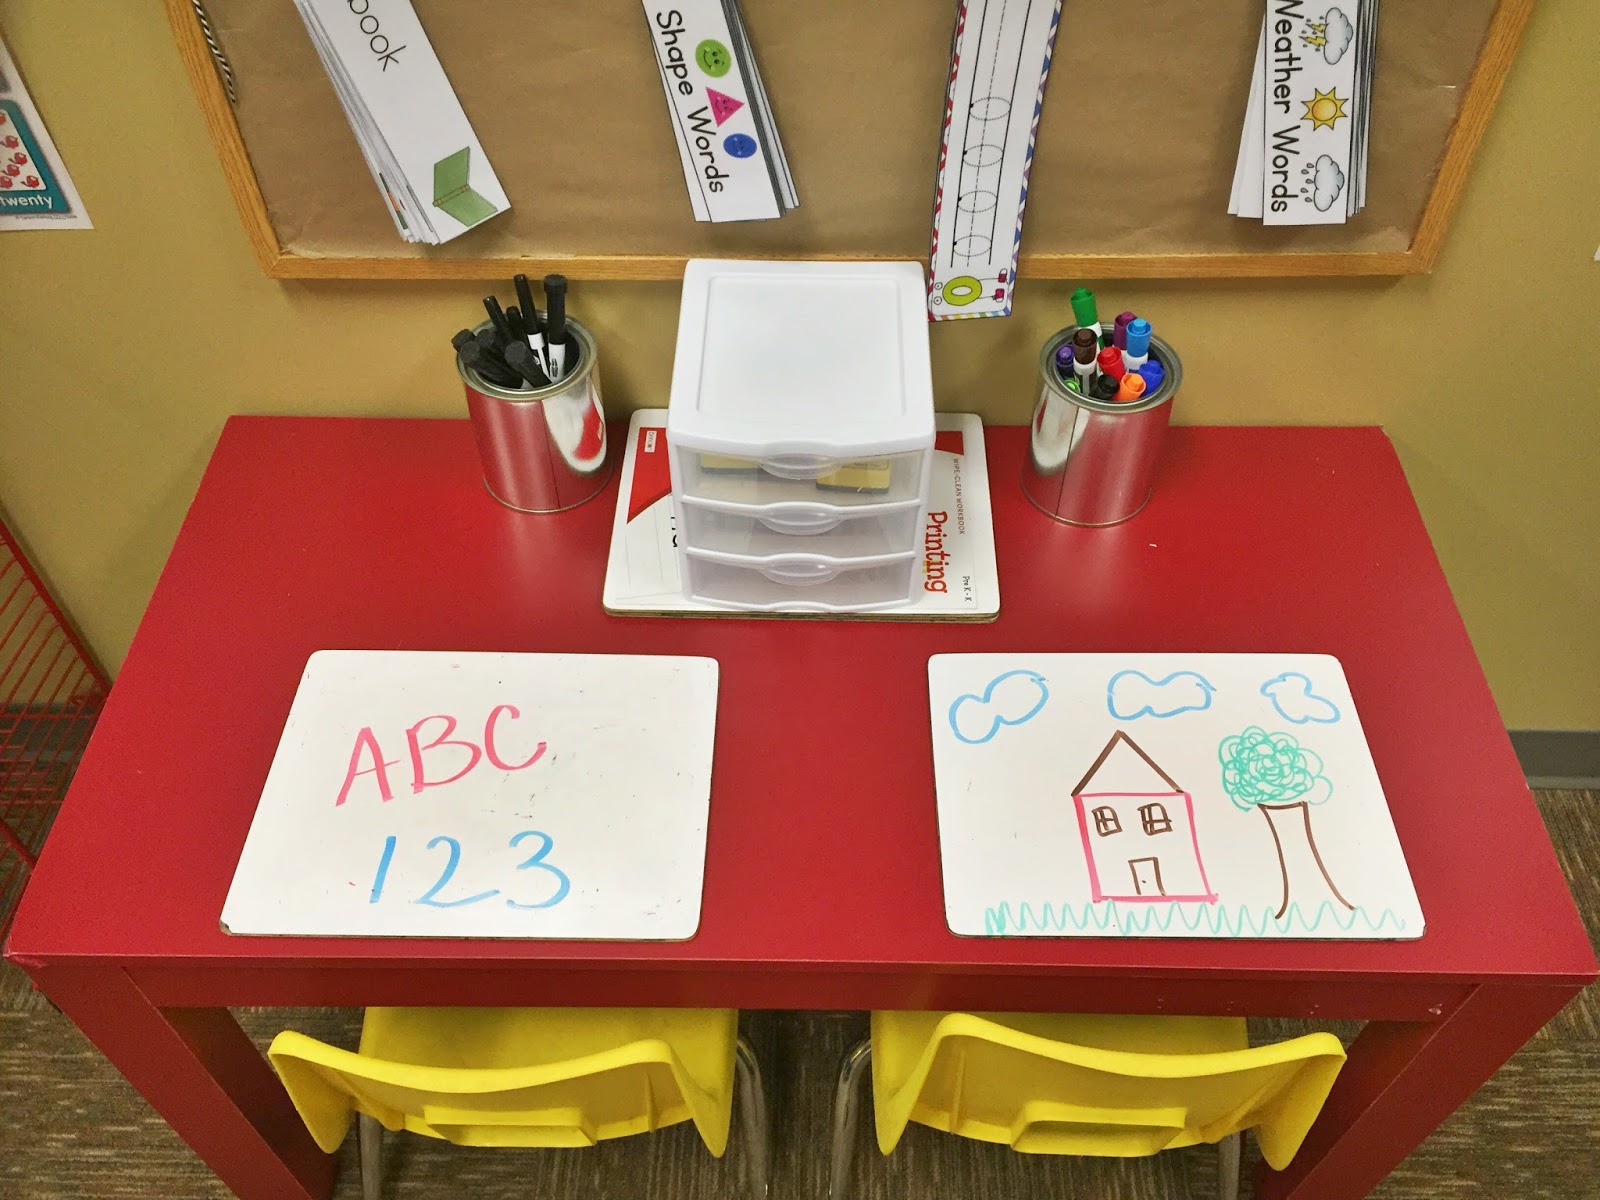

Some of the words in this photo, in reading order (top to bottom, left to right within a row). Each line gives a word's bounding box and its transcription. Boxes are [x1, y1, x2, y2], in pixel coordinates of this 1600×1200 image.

[656, 9, 693, 96] Shape
[687, 105, 730, 193] Words
[1270, 124, 1301, 212] Words
[0, 194, 52, 209] twenty
[953, 458, 962, 497] WIPE-CLEAN
[956, 498, 966, 535] WORKBOOK
[924, 511, 951, 594] Printing
[962, 576, 971, 586] Pre
[336, 704, 547, 807] ABC
